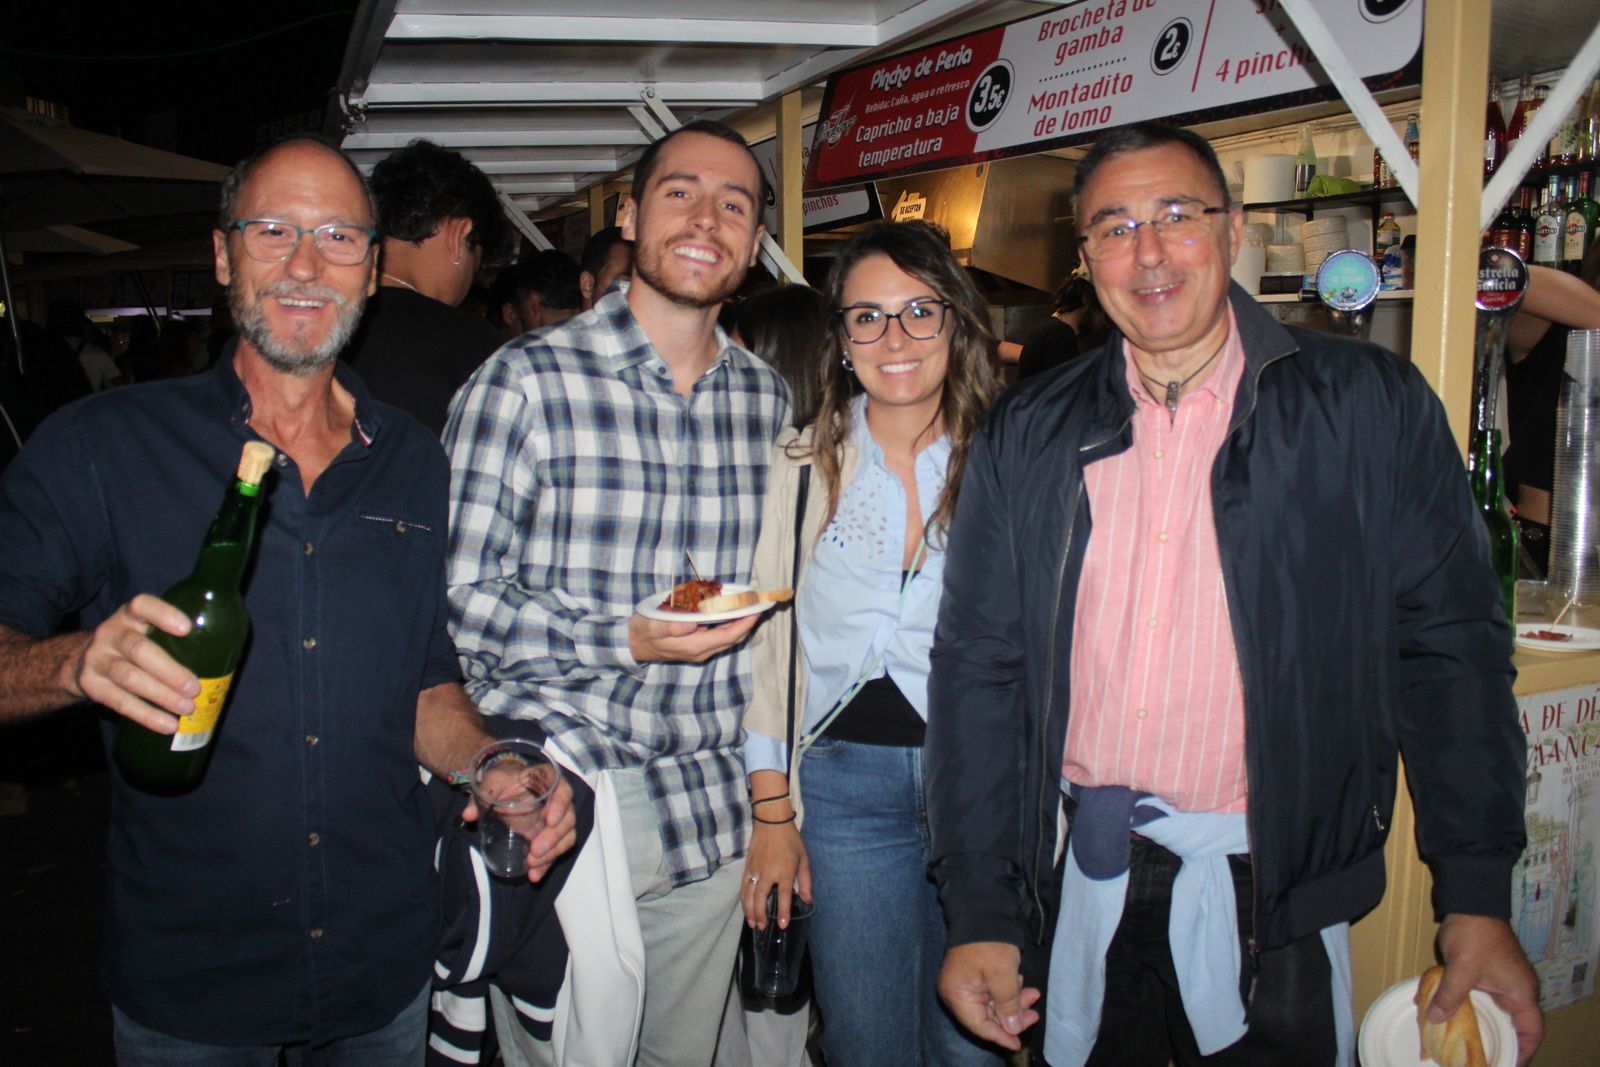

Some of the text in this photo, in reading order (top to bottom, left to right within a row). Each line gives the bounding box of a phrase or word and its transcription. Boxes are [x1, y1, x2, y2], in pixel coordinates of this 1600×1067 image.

[1038, 0, 1125, 42] Brocheta
[1054, 25, 1124, 66] gamba
[1160, 27, 1181, 62] 2€
[870, 65, 911, 92] Pincho
[914, 56, 932, 78] de
[1215, 43, 1317, 84] 4 pincho
[865, 79, 970, 114] Bebida: Caña, agua o refresco
[1027, 73, 1133, 115] Montadito
[856, 112, 912, 143] Capricho
[914, 115, 922, 129] a
[925, 104, 960, 127] baja
[1034, 105, 1112, 137] de lomo
[858, 136, 943, 168] temperatura
[803, 193, 839, 217] pinchos
[1479, 266, 1519, 279] strella
[1542, 701, 1567, 731] DE
